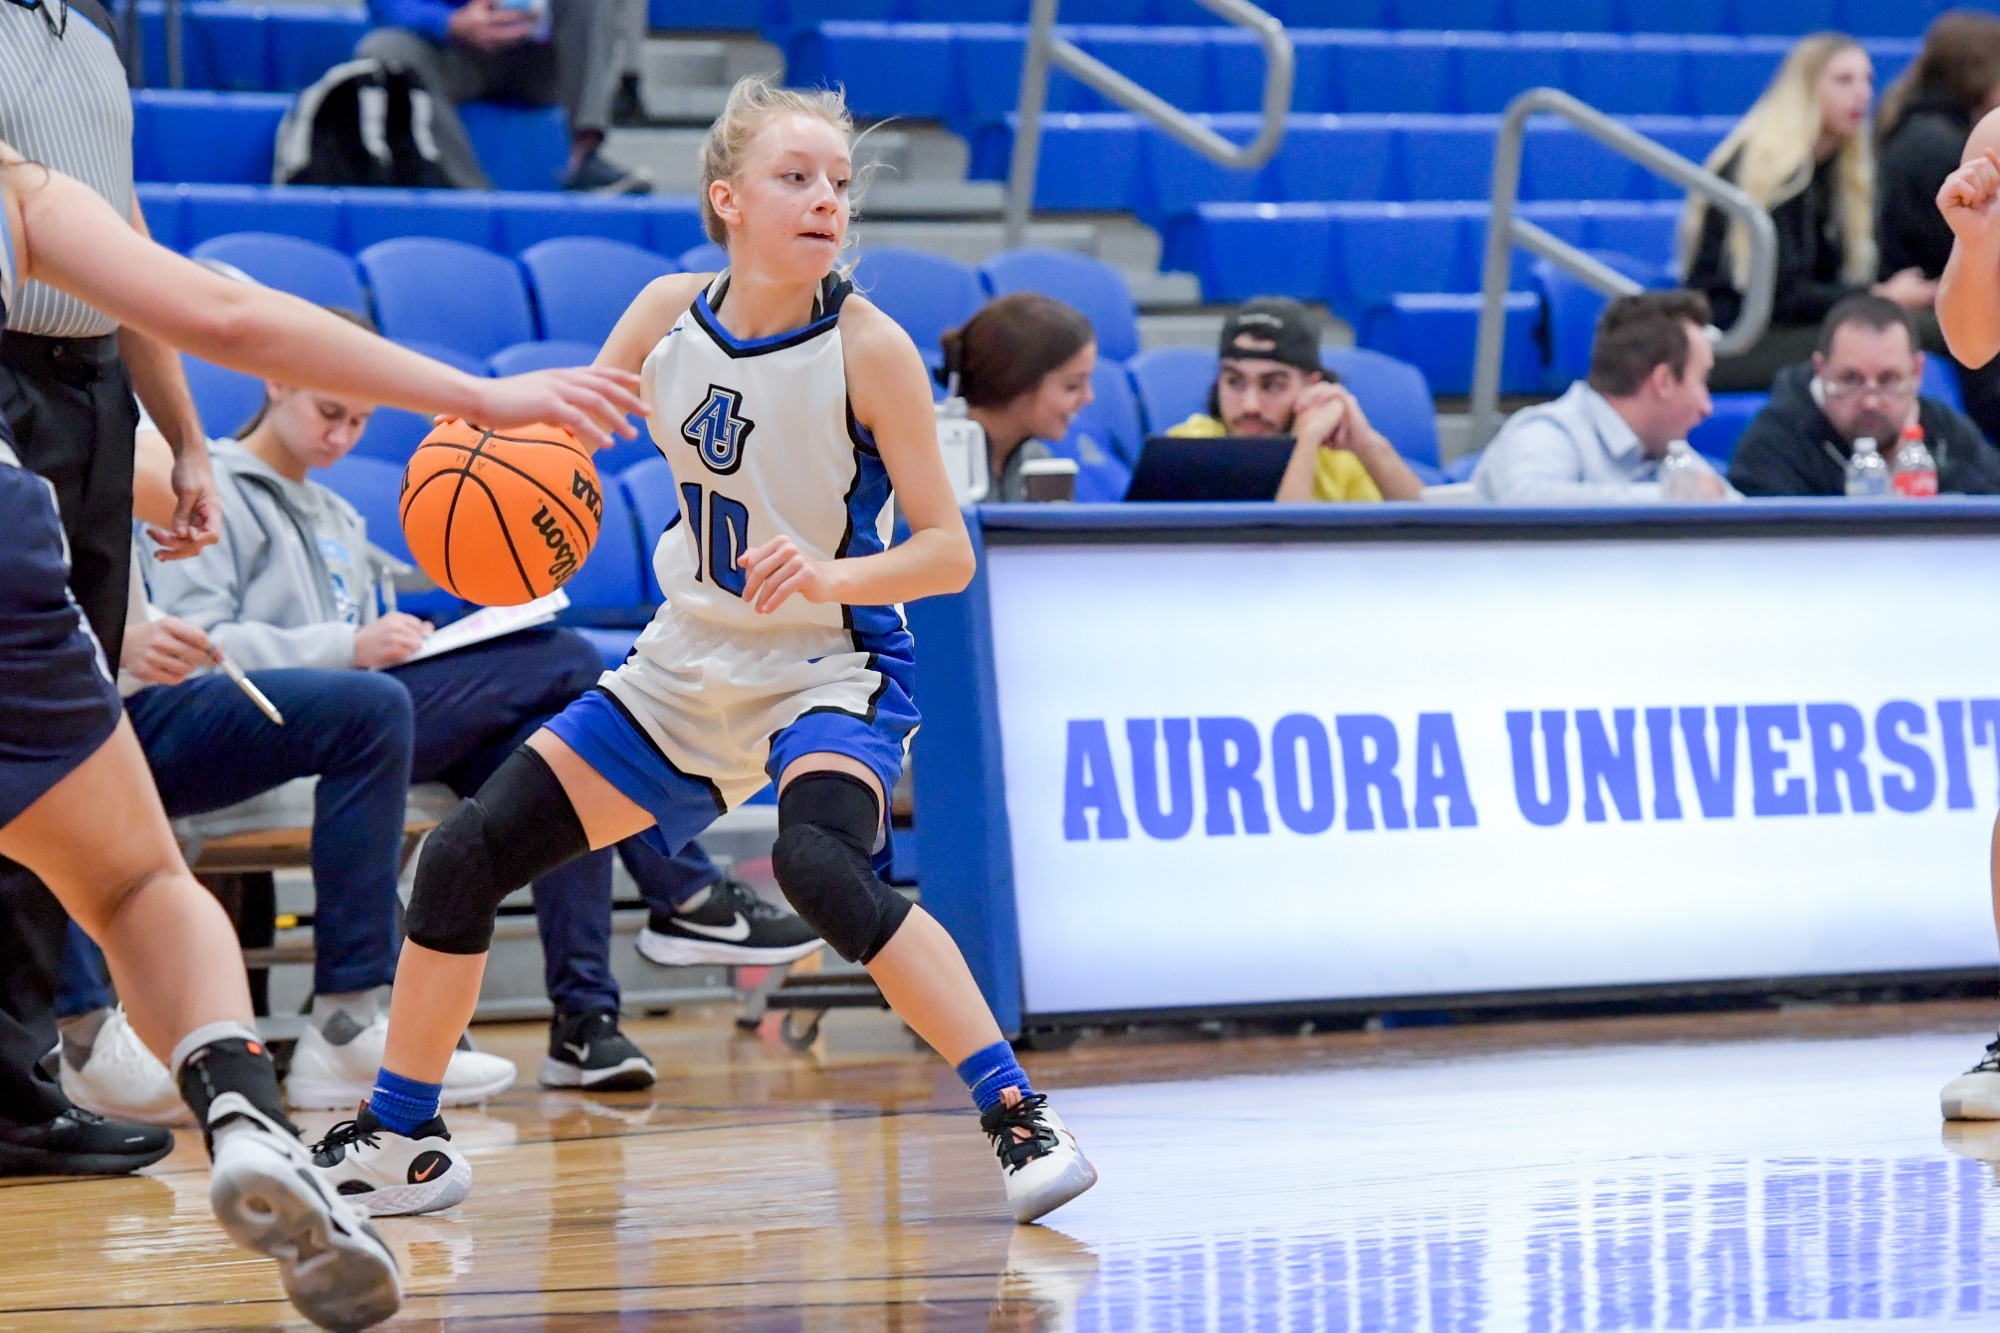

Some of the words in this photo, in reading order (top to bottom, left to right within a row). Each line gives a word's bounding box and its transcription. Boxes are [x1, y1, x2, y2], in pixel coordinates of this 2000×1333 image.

[682, 384, 754, 475] AU
[571, 468, 603, 530] CAA
[680, 482, 749, 598] 10
[1062, 711, 1478, 842] AURORA
